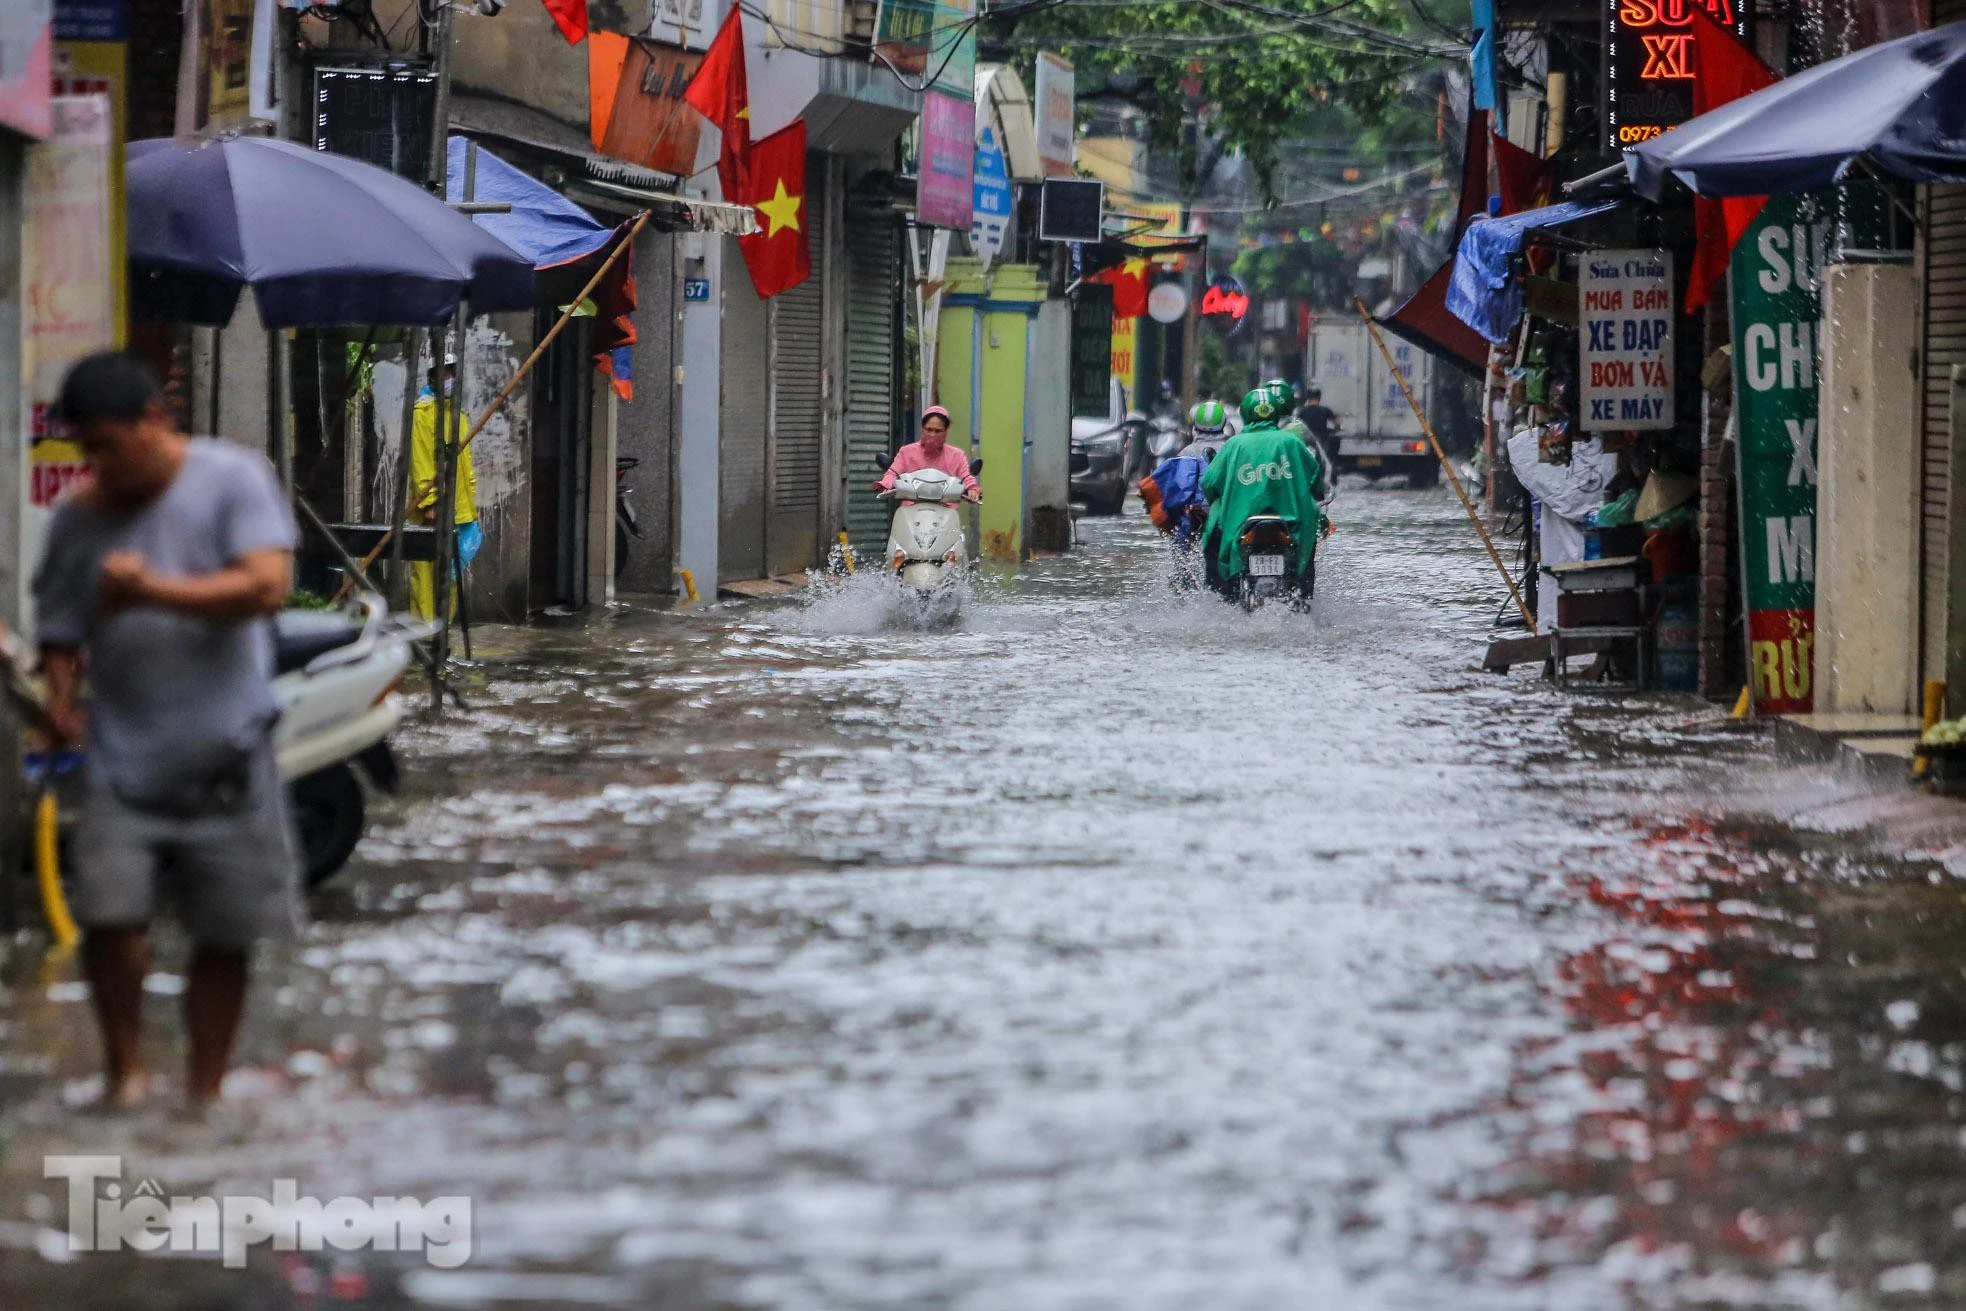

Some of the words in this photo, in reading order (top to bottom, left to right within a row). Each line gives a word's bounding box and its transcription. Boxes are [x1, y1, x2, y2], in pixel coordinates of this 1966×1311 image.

[686, 281, 704, 297] 57
[1585, 290, 1622, 311] MUA
[1633, 285, 1669, 310] BÁN
[1588, 320, 1616, 351] XE
[1623, 319, 1667, 357] ĐẠP
[1590, 359, 1634, 387] BƠM
[1640, 354, 1667, 387] VÁ
[1744, 323, 1820, 391] CH
[1591, 399, 1615, 420] XE
[1621, 394, 1664, 419] MÁY
